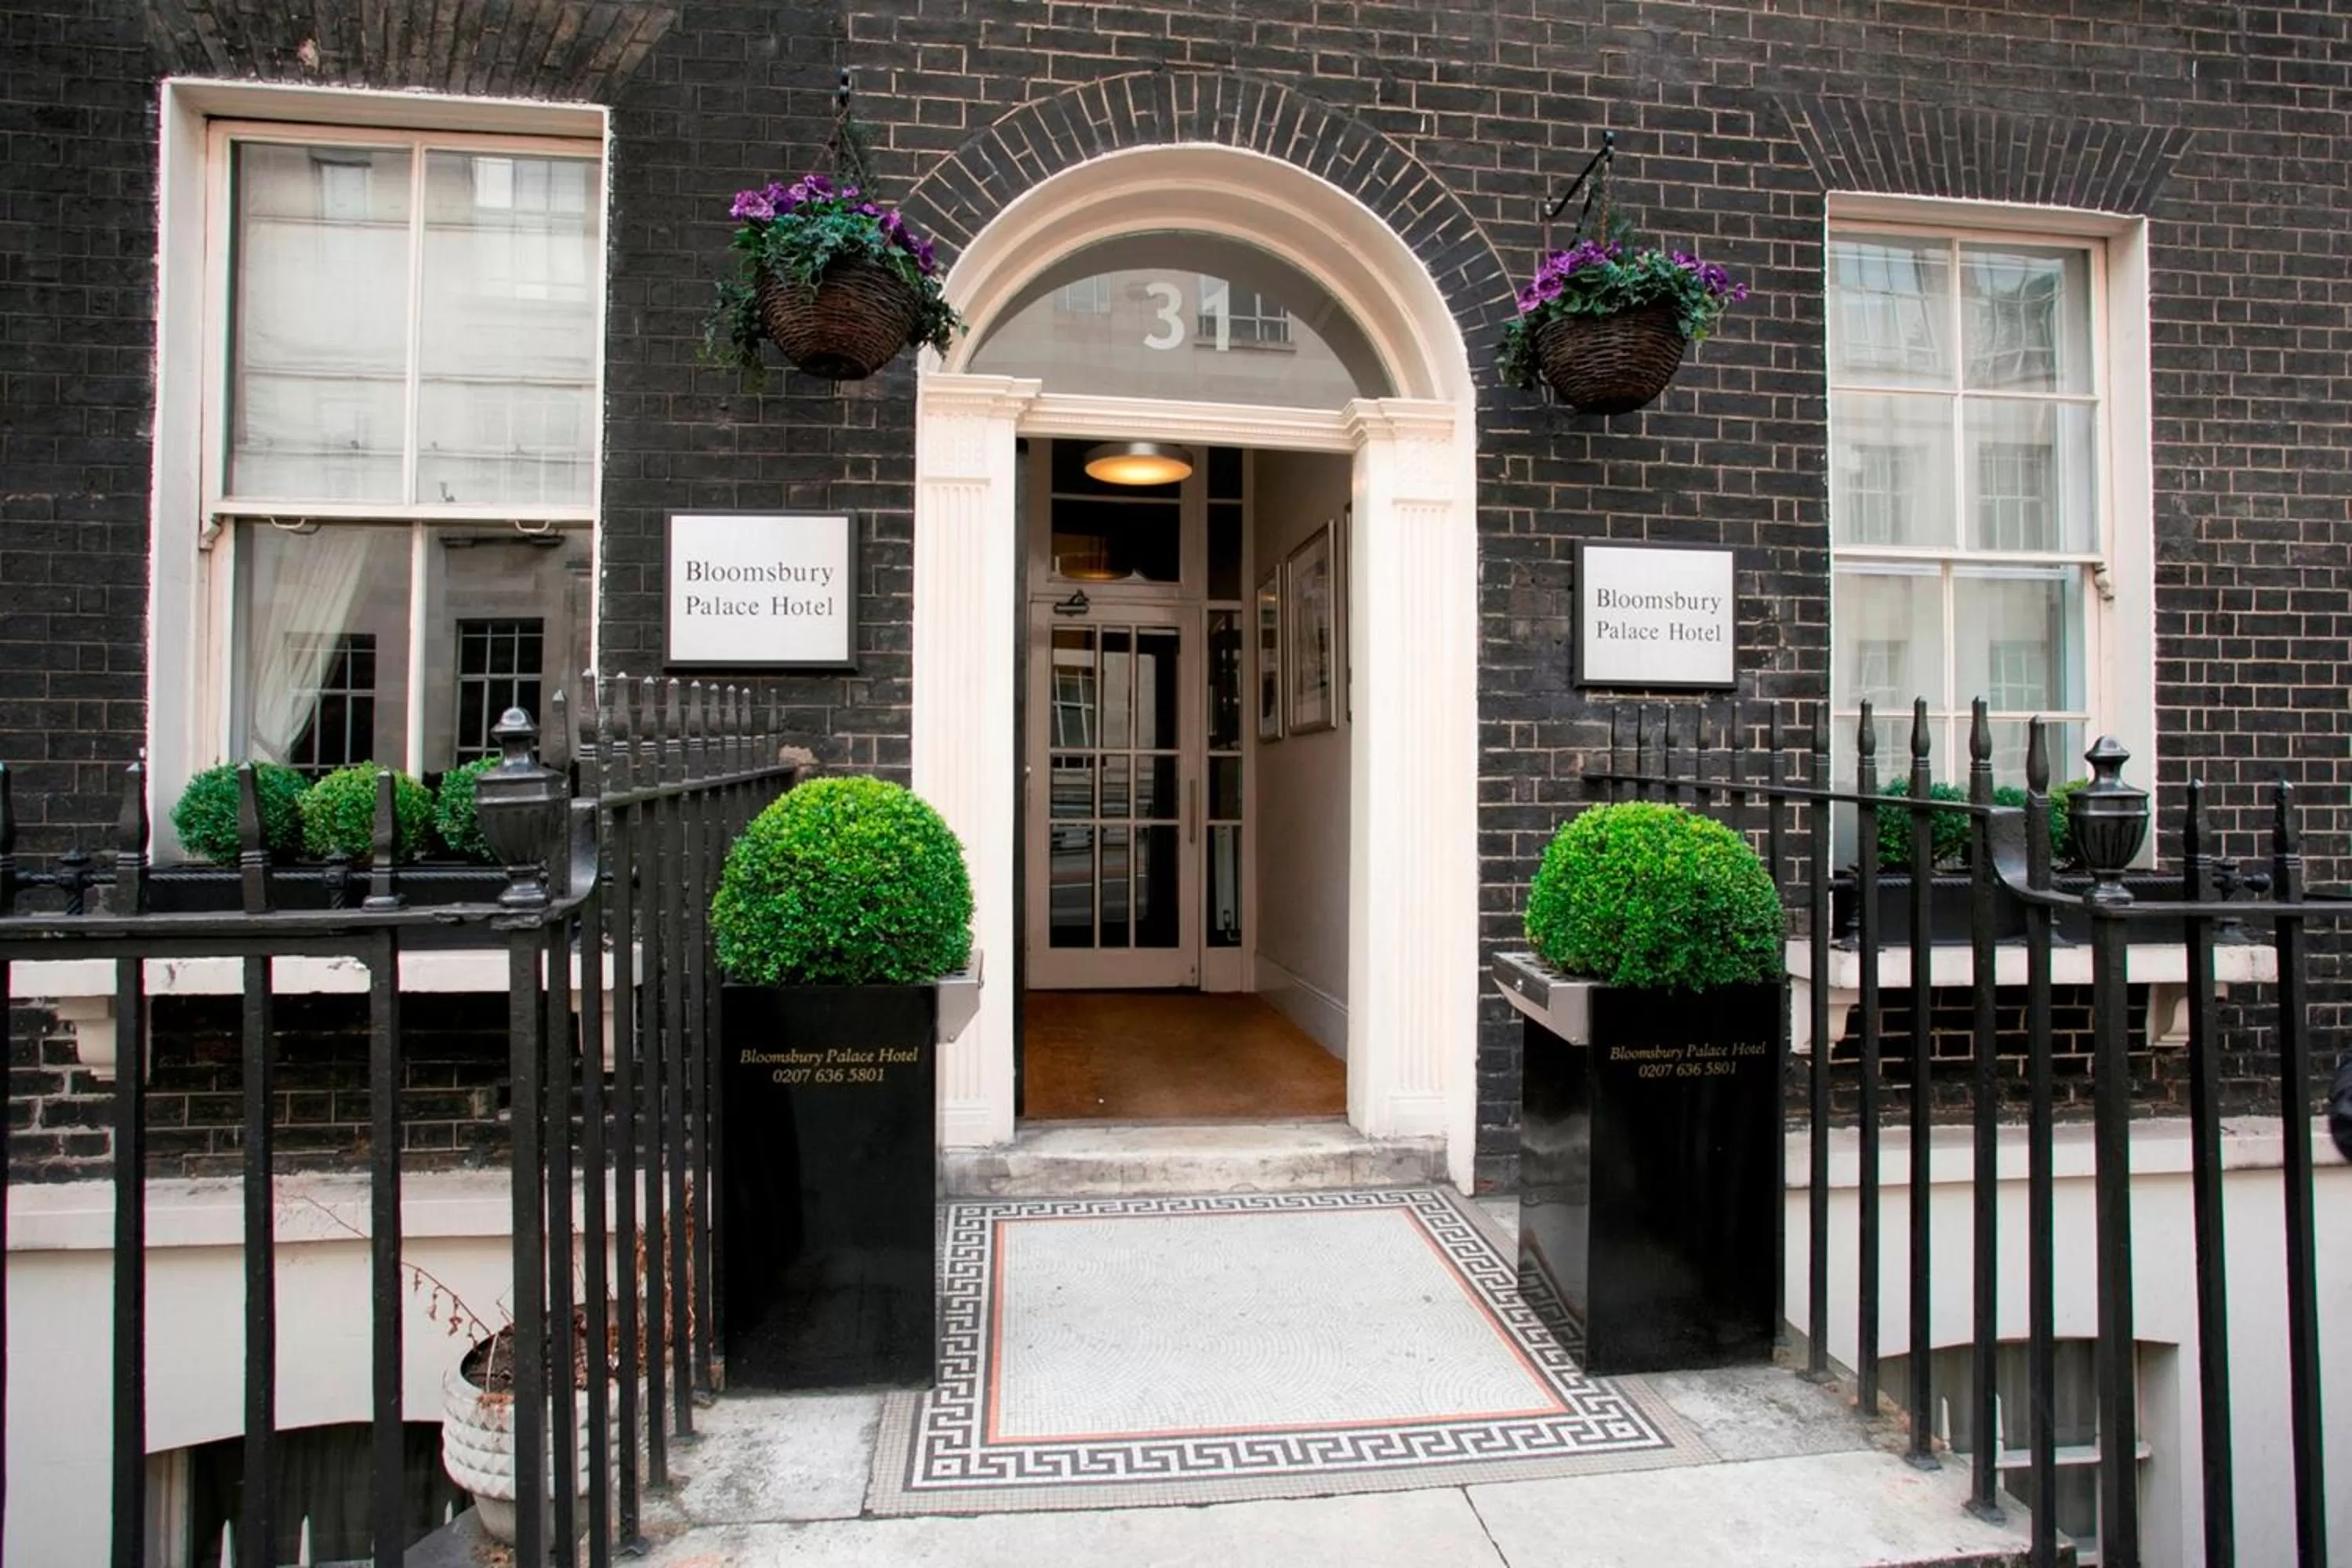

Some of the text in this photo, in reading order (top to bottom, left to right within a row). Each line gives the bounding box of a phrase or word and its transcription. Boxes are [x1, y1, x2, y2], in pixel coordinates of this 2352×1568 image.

[1143, 280, 1229, 351] 31
[685, 561, 833, 586] Bloomsbury
[685, 596, 833, 615] Palace Hotel
[1596, 588, 1722, 615] Bloomsbury
[1596, 620, 1722, 641] Palace Hotel
[740, 1047, 919, 1067] Bloomsbury Palace Hotel
[1610, 1041, 1766, 1062] Bloomsbury Palace Hotel
[772, 1068, 884, 1083] 0207 636 5801
[1639, 1061, 1737, 1078] 0207 636 5801
